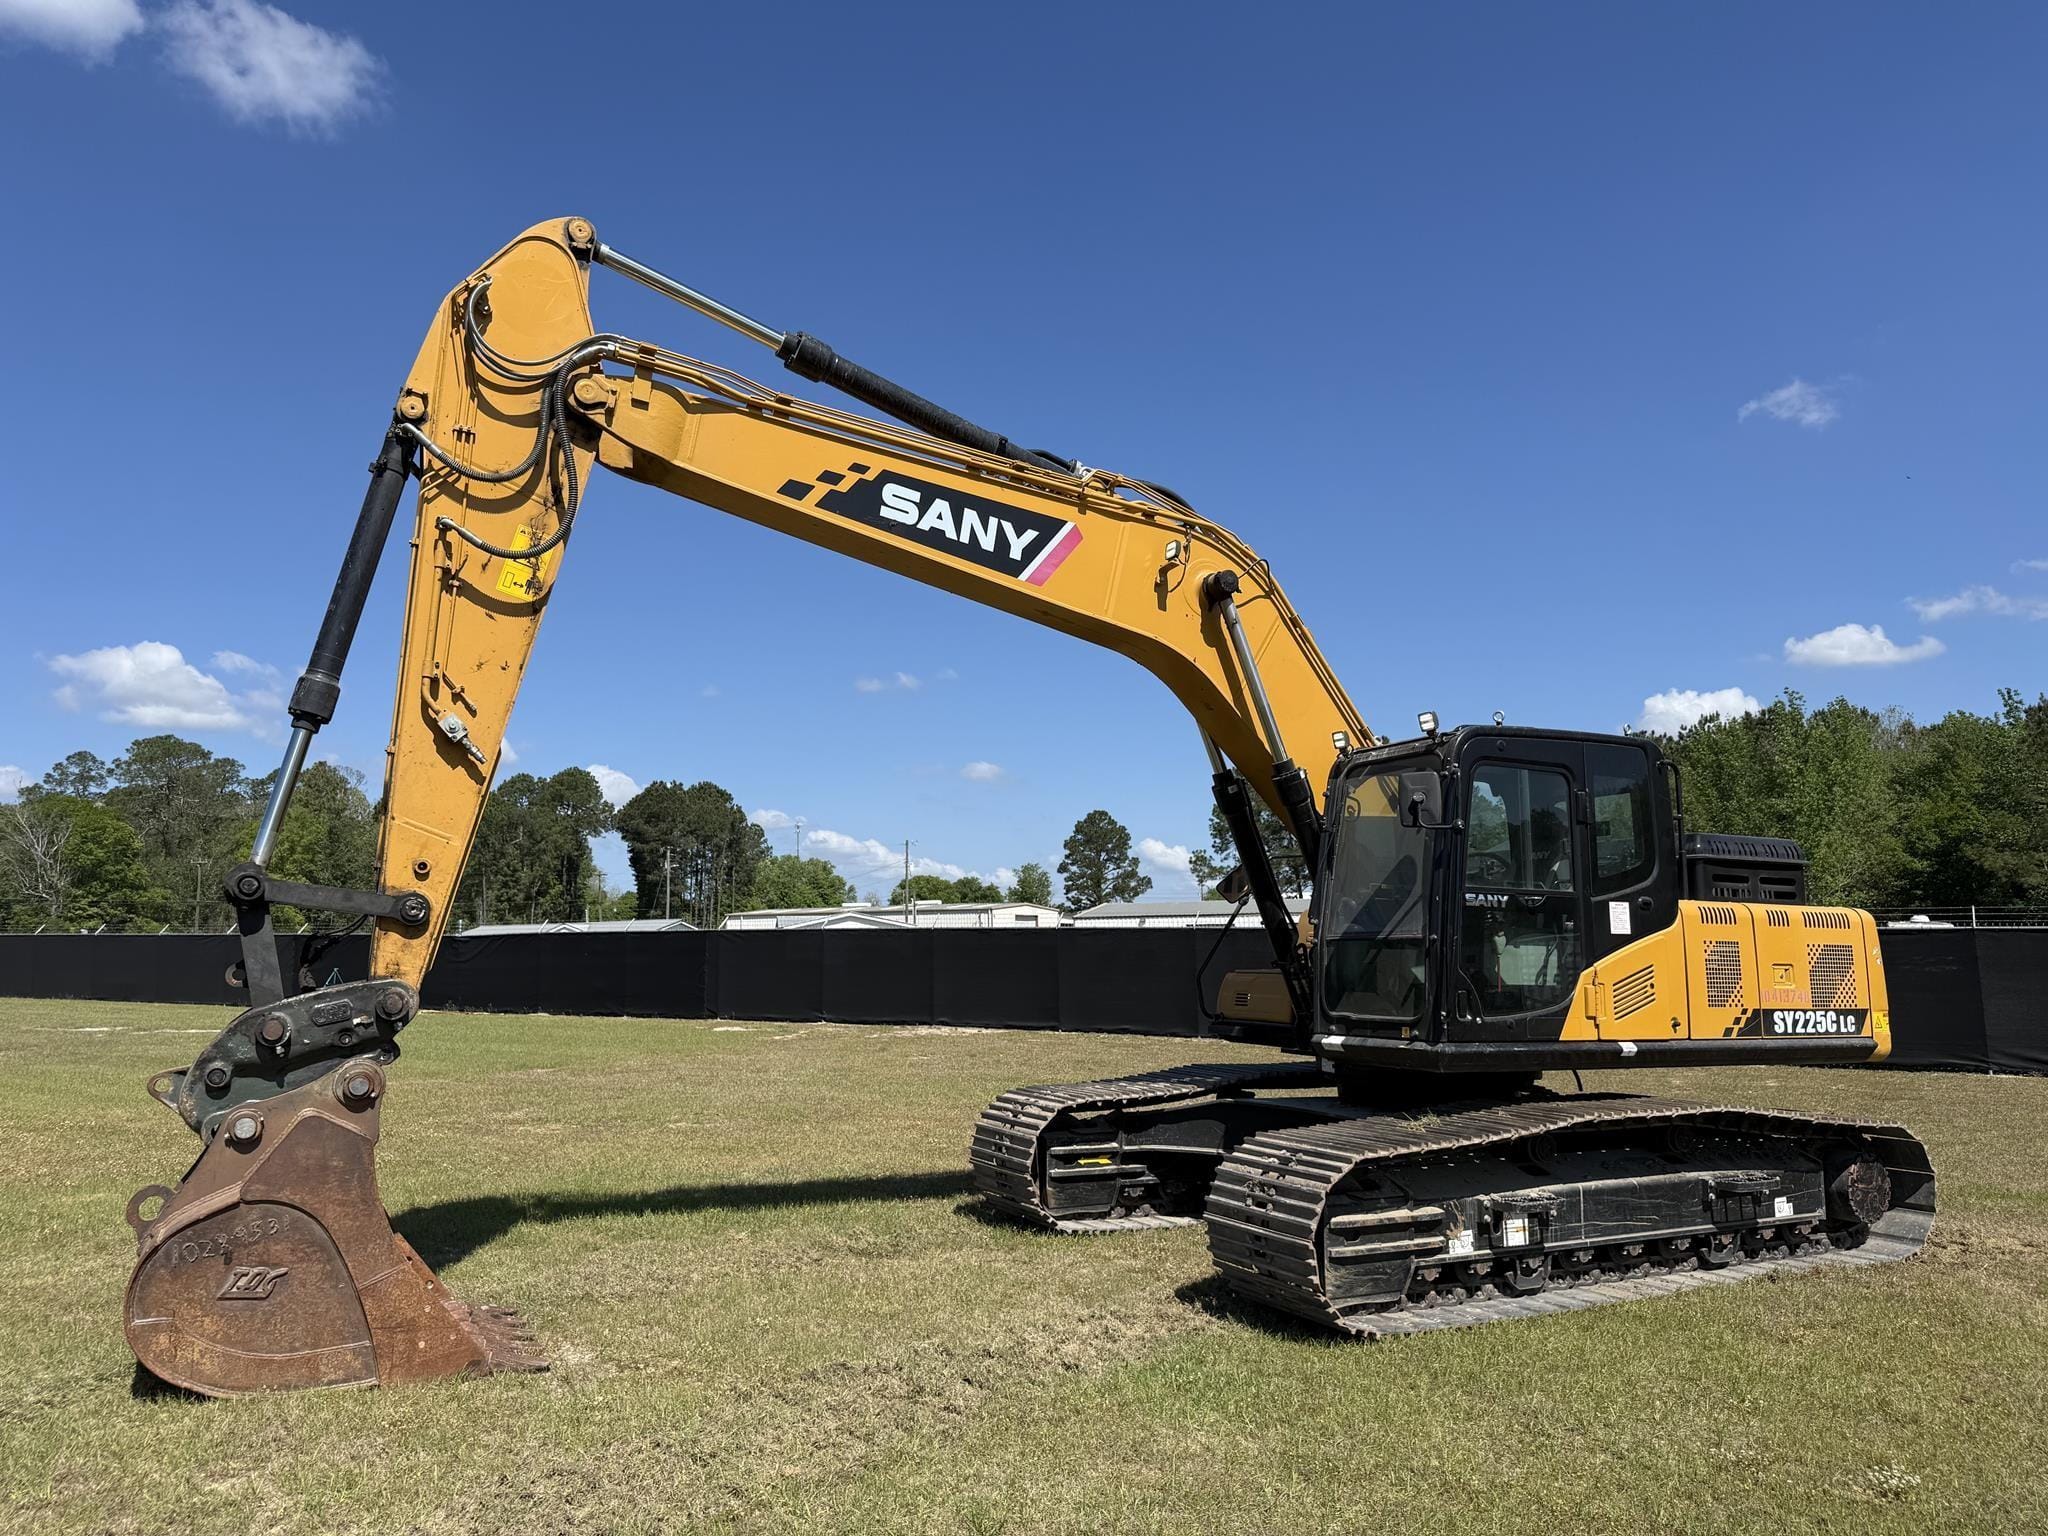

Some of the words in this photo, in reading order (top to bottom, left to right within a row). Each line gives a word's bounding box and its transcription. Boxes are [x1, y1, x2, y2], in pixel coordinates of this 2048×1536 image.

[879, 483, 1039, 561] SANY
[1465, 893, 1509, 908] SANY
[1773, 1010, 1837, 1034] SY225C
[1839, 1015, 1856, 1033] LC
